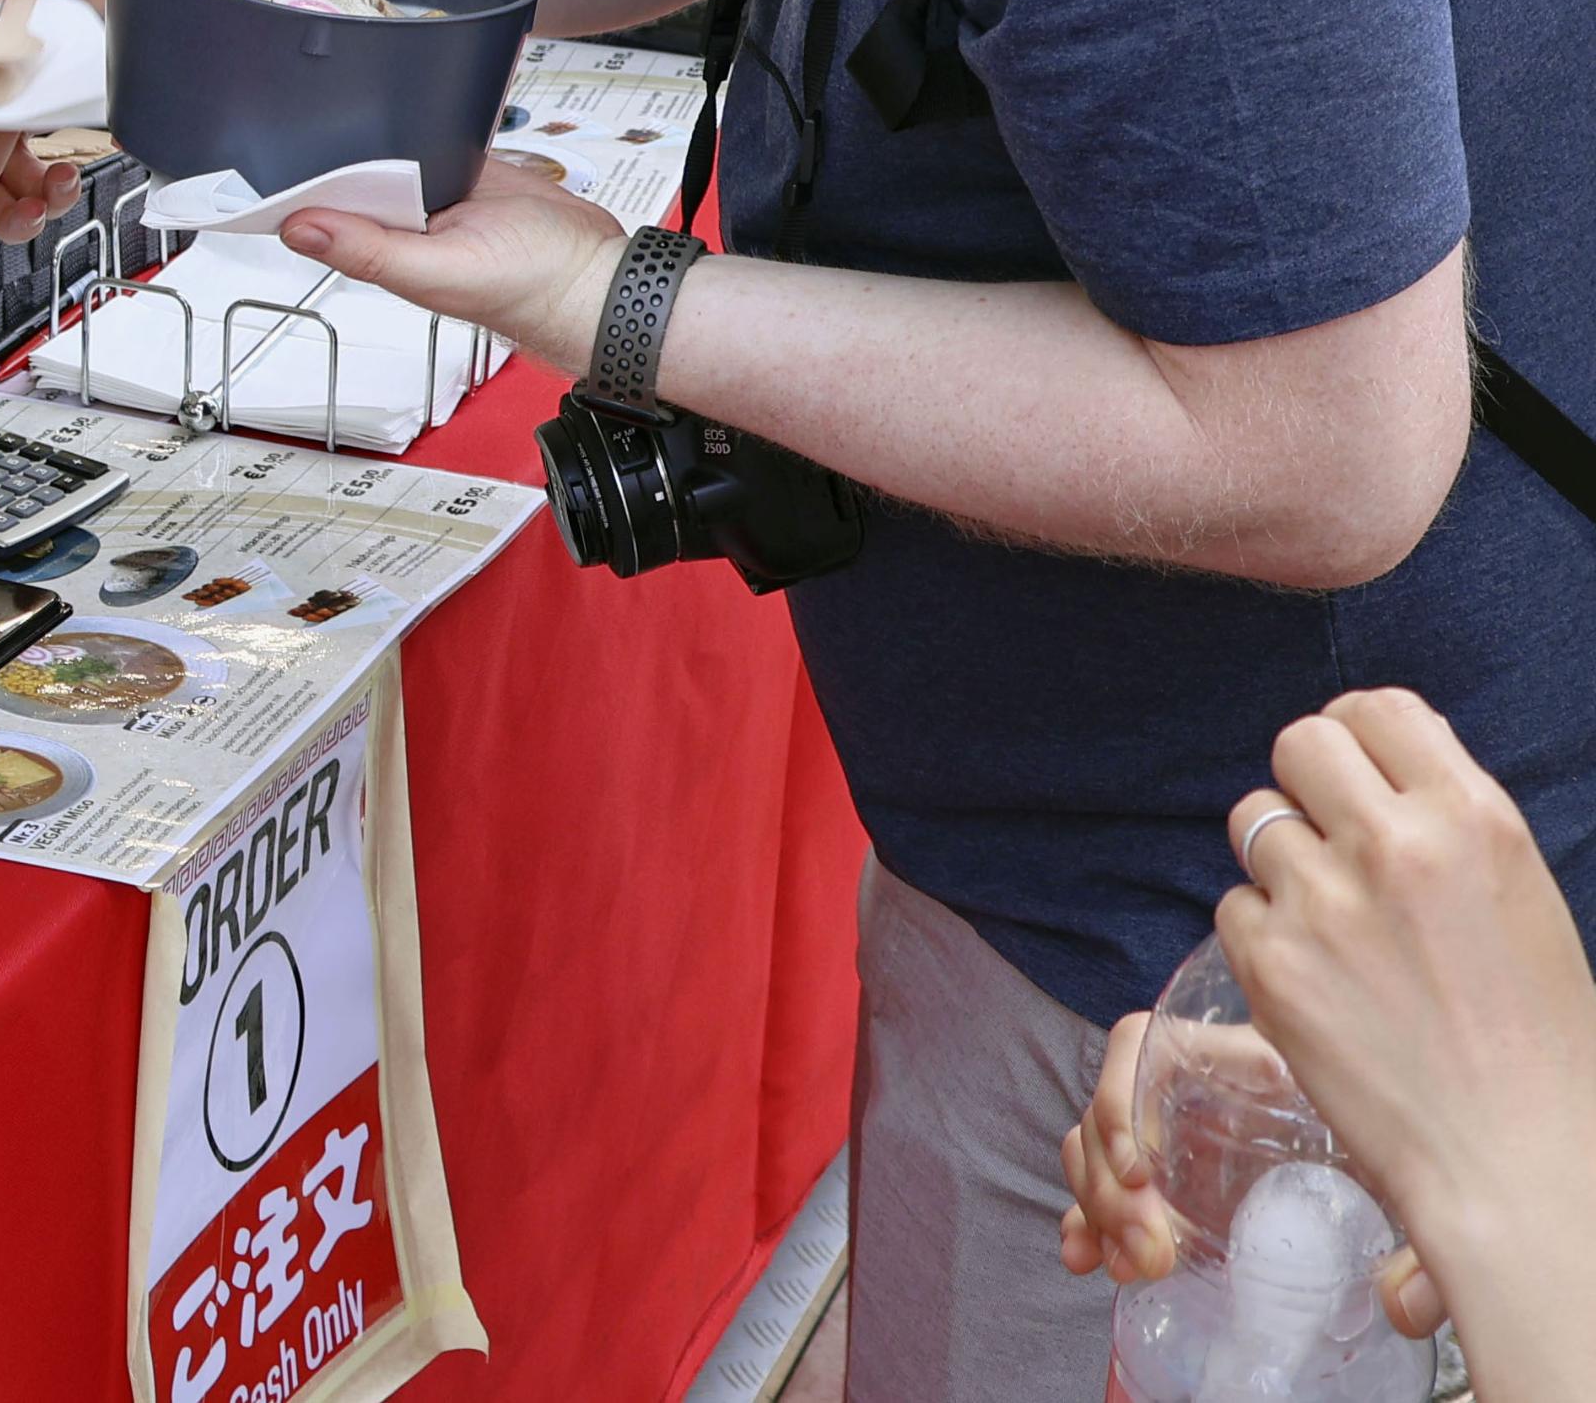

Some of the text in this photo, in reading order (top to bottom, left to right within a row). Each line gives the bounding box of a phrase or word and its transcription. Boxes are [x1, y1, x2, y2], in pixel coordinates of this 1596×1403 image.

[613, 431, 623, 440] AF
[704, 442, 731, 455] 250D
[705, 429, 727, 441] EOS
[158, 720, 187, 740] Miso
[9, 823, 40, 844] Nr.3
[28, 799, 94, 850] VEGAN Miso
[179, 758, 341, 1006] ORDER
[235, 980, 269, 1116] 1
[171, 1122, 373, 1403] ご注文
[303, 1279, 364, 1370] Only
